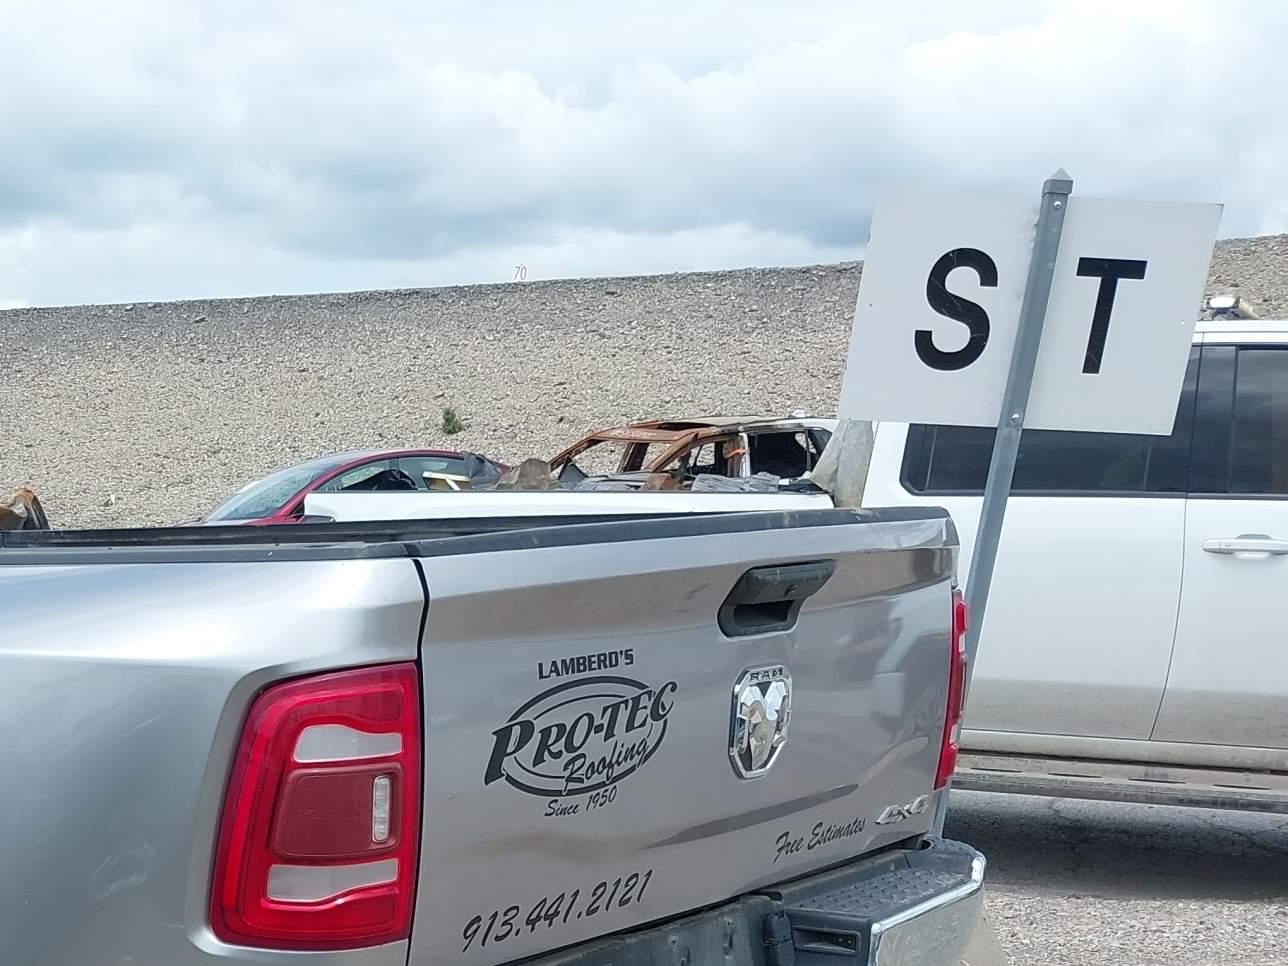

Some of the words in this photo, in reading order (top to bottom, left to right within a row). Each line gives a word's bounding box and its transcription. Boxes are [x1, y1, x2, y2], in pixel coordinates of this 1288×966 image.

[514, 264, 527, 281] 70
[914, 247, 998, 371] S
[1076, 257, 1148, 375] T
[538, 648, 634, 680] LAMBERD'S
[750, 667, 784, 681] RAM
[484, 681, 677, 786] PRO-TEC
[562, 738, 650, 793] Roofing
[544, 799, 579, 817] Since
[586, 786, 617, 812] 1950
[773, 831, 803, 863] Free
[808, 817, 865, 850] Estimates
[462, 869, 653, 953] 913.441.2121
